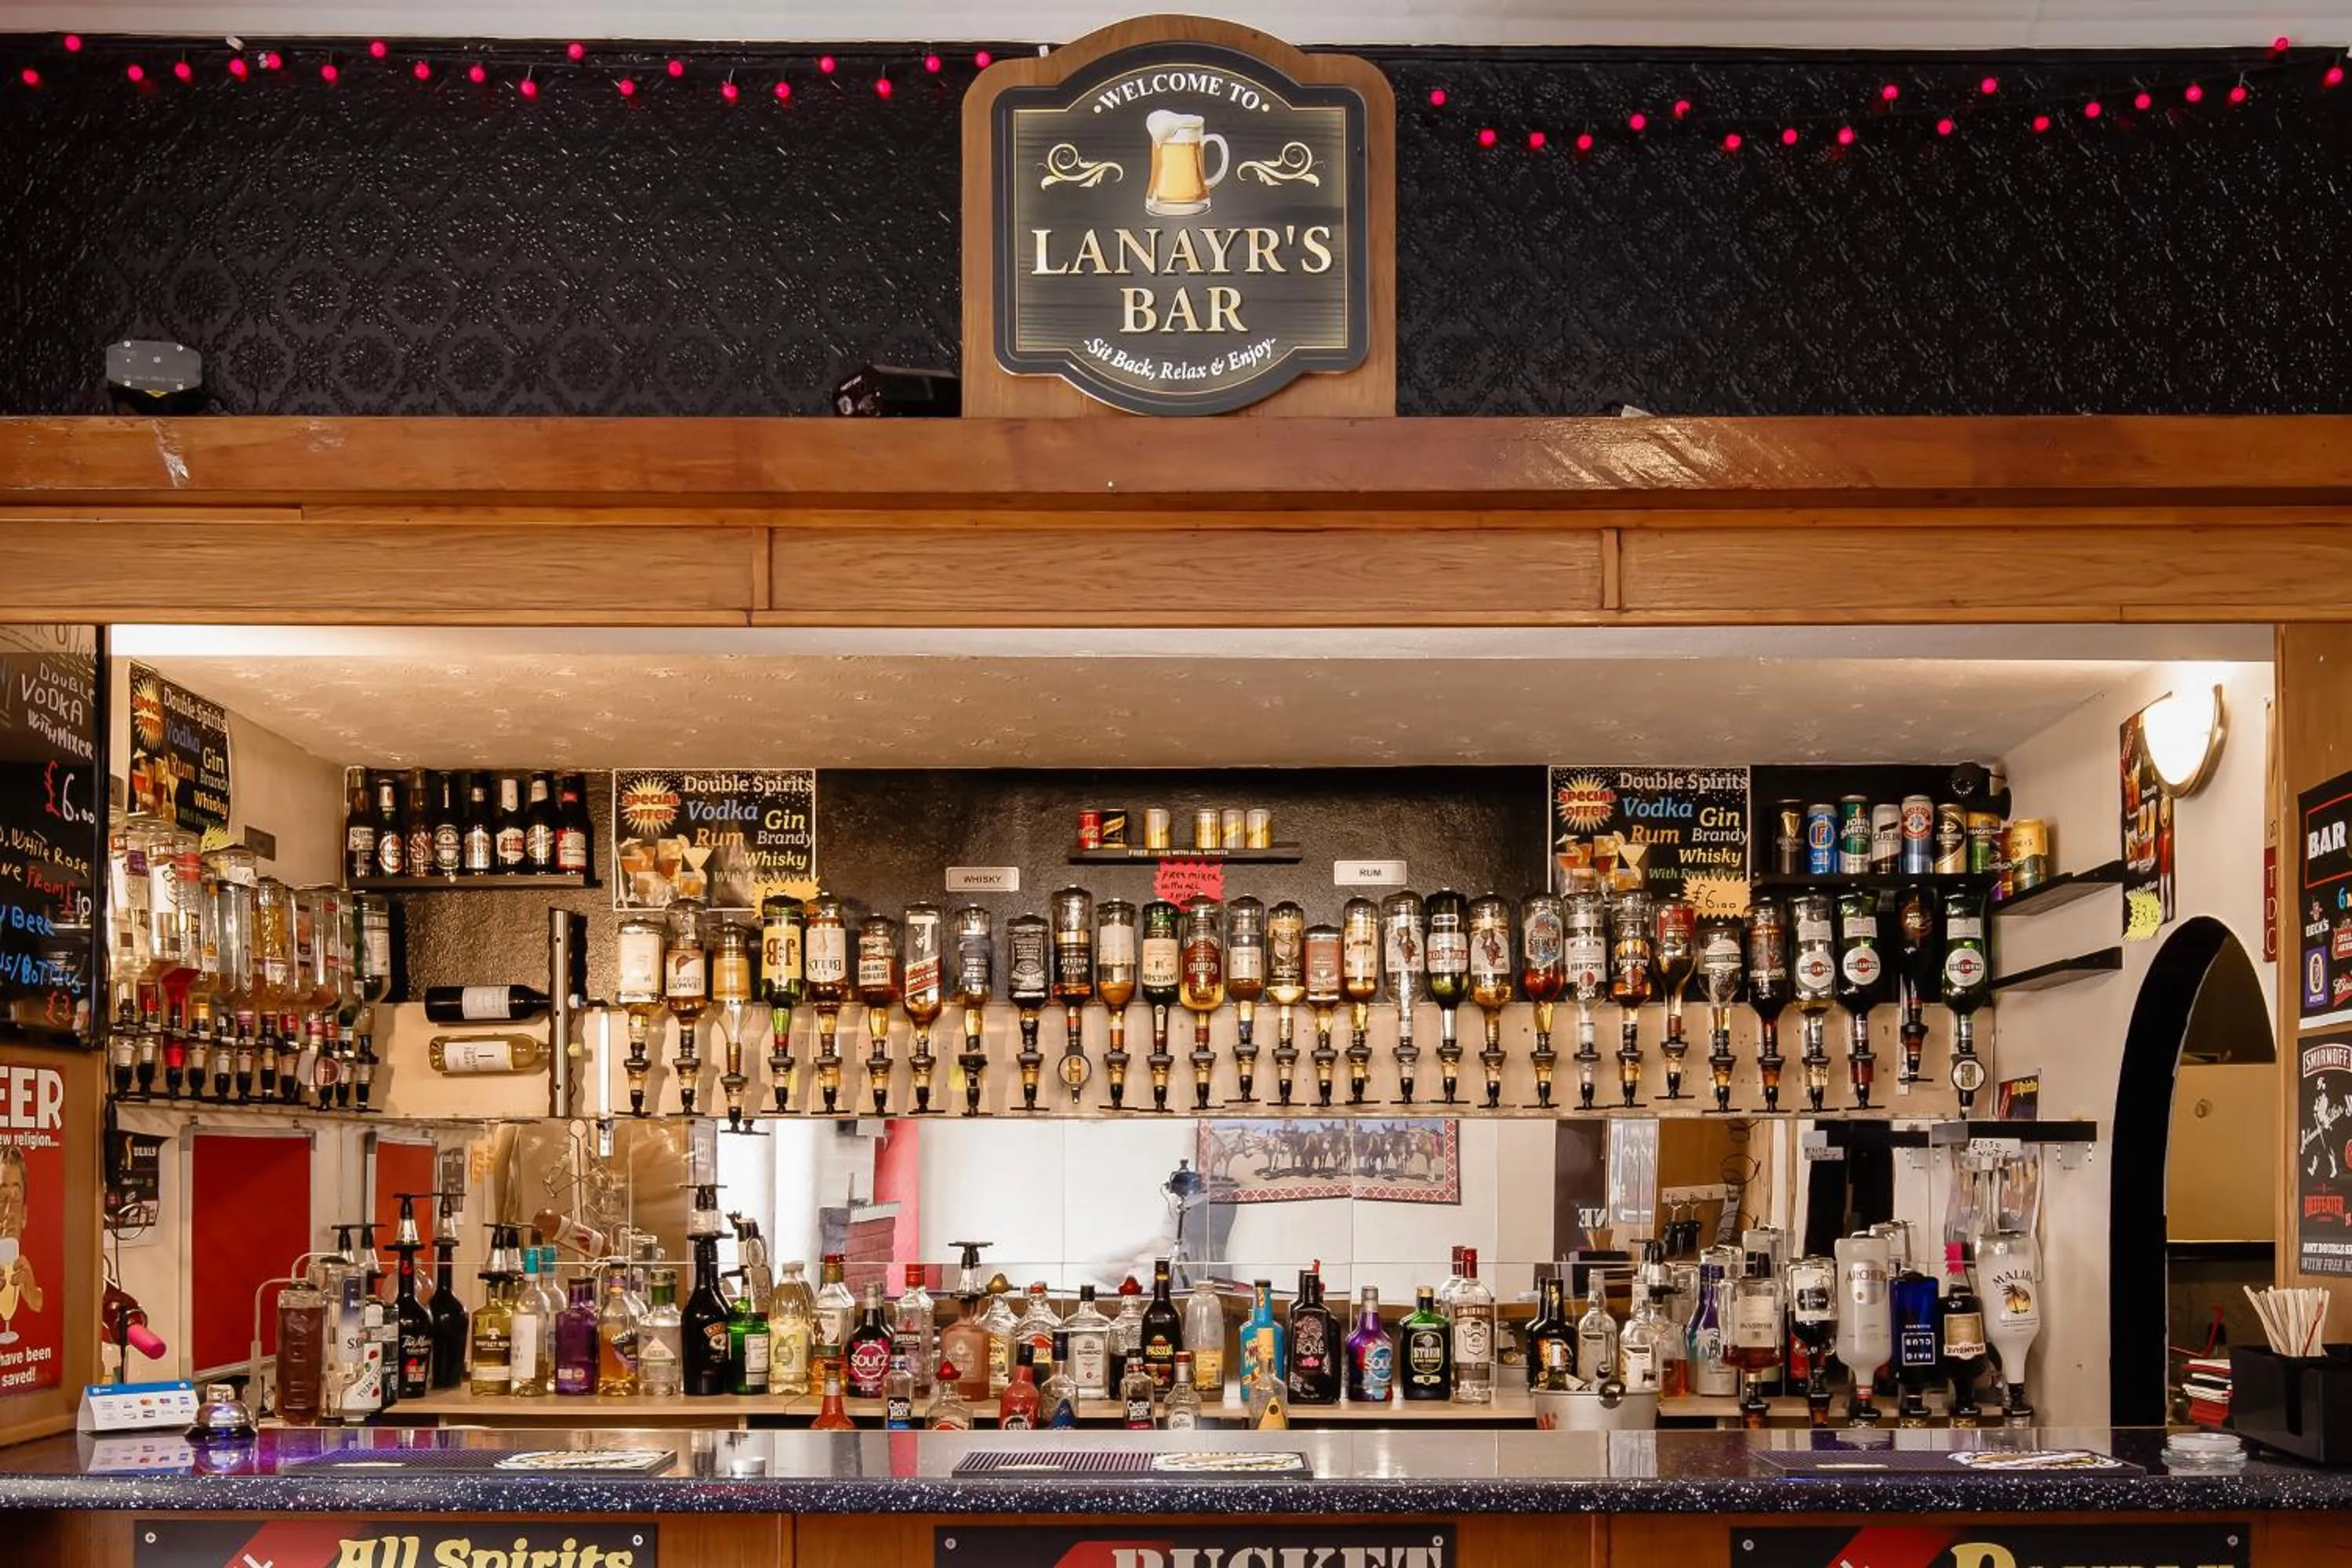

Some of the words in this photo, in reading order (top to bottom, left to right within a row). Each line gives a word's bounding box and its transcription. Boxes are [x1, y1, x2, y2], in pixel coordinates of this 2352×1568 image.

[1099, 72, 1221, 110] WELCOME
[1229, 81, 1262, 111] TO
[1030, 225, 1333, 276] LANAYR'S
[1119, 286, 1250, 335] BAR
[1114, 354, 1156, 381] Back,
[1160, 361, 1207, 380] Relax
[1210, 358, 1225, 376] &
[163, 687, 195, 719] Double
[197, 703, 228, 733] Spirits
[165, 717, 200, 753] Vodka
[169, 752, 196, 782] Rum
[203, 747, 224, 774] Gin
[200, 767, 230, 796] Brandy
[684, 775, 750, 793] Double
[753, 775, 815, 797] Spirits
[1619, 771, 1683, 790] Double
[1688, 772, 1749, 794] Spirits
[194, 789, 228, 820] Whisky
[687, 799, 759, 821] Vodka
[1622, 797, 1693, 818] Vodka
[764, 810, 806, 830] Gin
[1699, 807, 1740, 827] Gin
[695, 827, 745, 847] Rum
[757, 829, 813, 848] Brandy
[1629, 825, 1680, 844] Rum
[1691, 827, 1749, 845] Brandy
[2308, 821, 2347, 860] BAR
[744, 851, 807, 869] Whisky
[1679, 848, 1742, 866] Whisky
[713, 871, 743, 884] With
[964, 875, 1002, 884] WHISKY
[1359, 868, 1382, 877] RUM
[1648, 868, 1679, 880] With
[26, 1346, 51, 1363] been
[1296, 1343, 1324, 1356] ROSE
[2, 1367, 36, 1386] saved!
